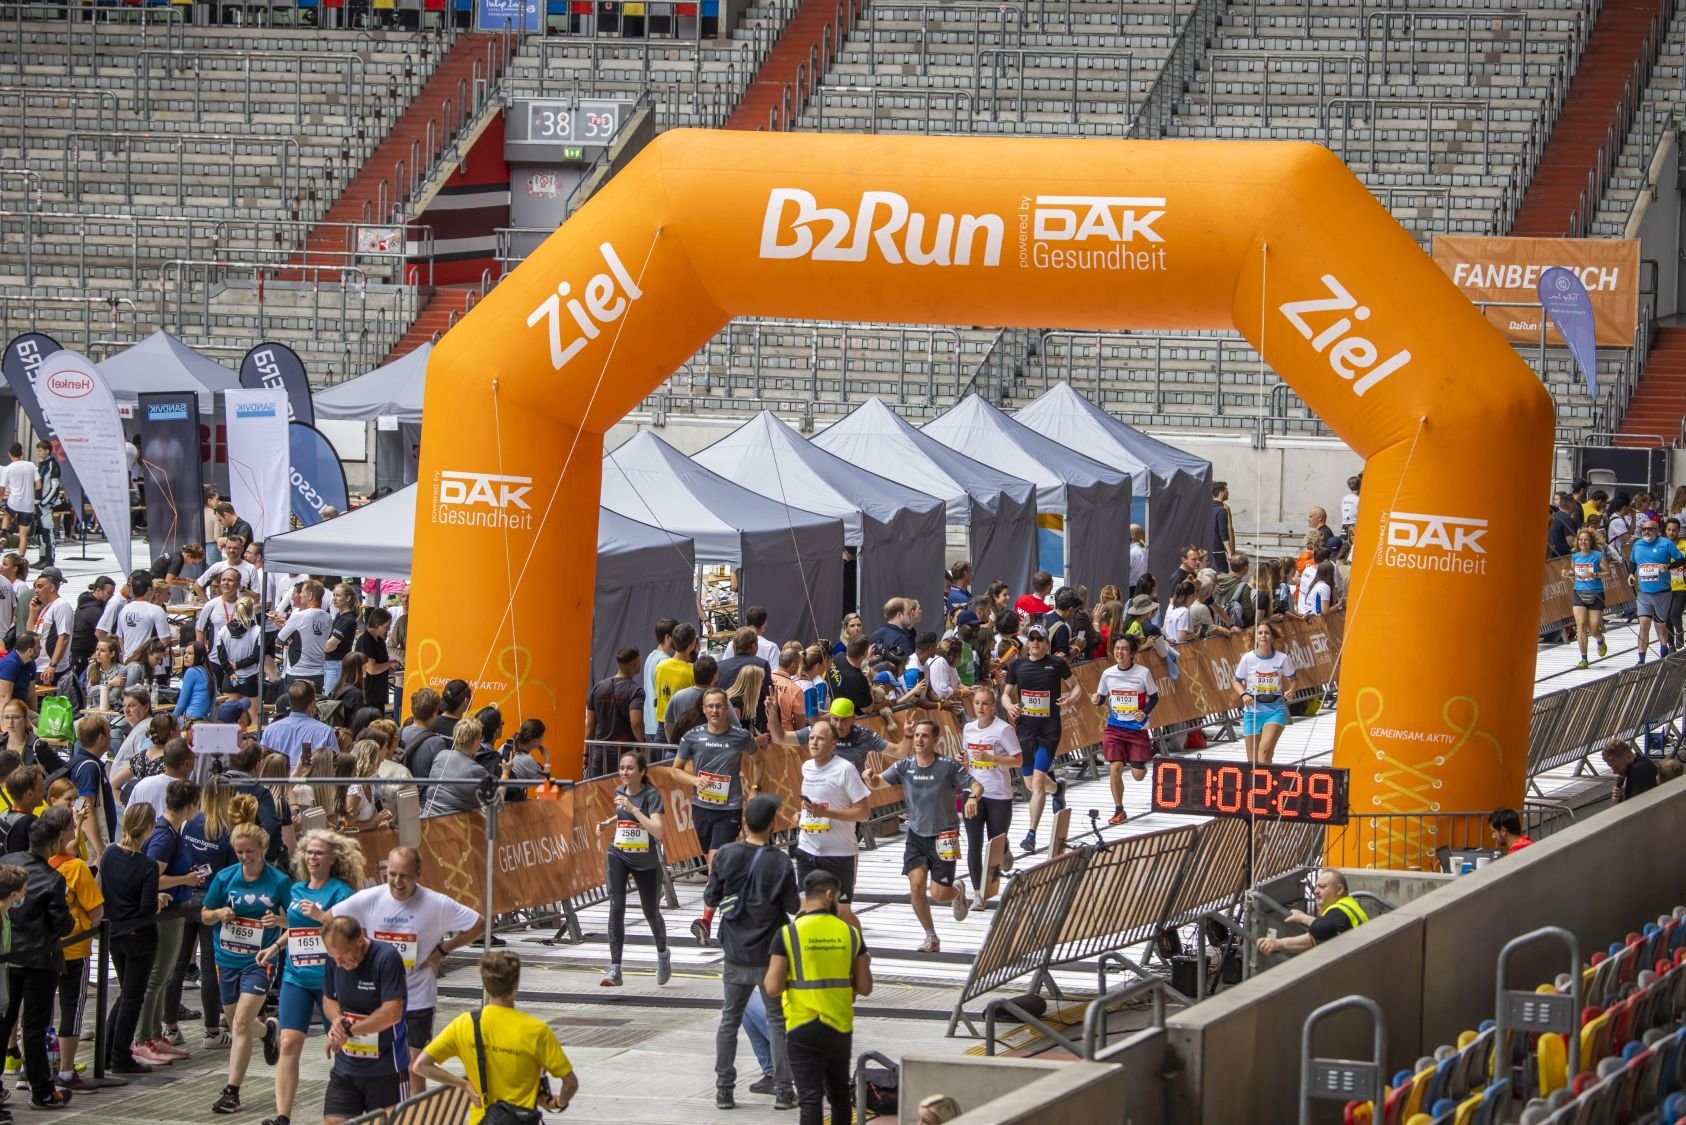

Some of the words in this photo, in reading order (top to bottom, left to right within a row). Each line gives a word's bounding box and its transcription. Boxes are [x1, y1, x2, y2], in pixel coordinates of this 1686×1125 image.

[541, 111, 570, 136] 38
[585, 112, 613, 137] 39
[1019, 195, 1031, 211] by
[760, 187, 1005, 267] B2Run
[1034, 195, 1168, 243] DAK
[1019, 213, 1029, 269] powered
[1033, 241, 1168, 271] Gesundheit
[1453, 263, 1619, 291] FANBECH
[527, 242, 643, 371] Ziel
[1278, 273, 1412, 397] Ziel
[440, 470, 533, 510] DAK
[439, 503, 533, 530] Gesundheit
[1387, 511, 1489, 554] DAK
[1385, 546, 1488, 575] Gesundheit
[1028, 697, 1041, 705] 801
[621, 829, 641, 838] 2580
[230, 926, 254, 938] 1659
[298, 937, 319, 947] 1651
